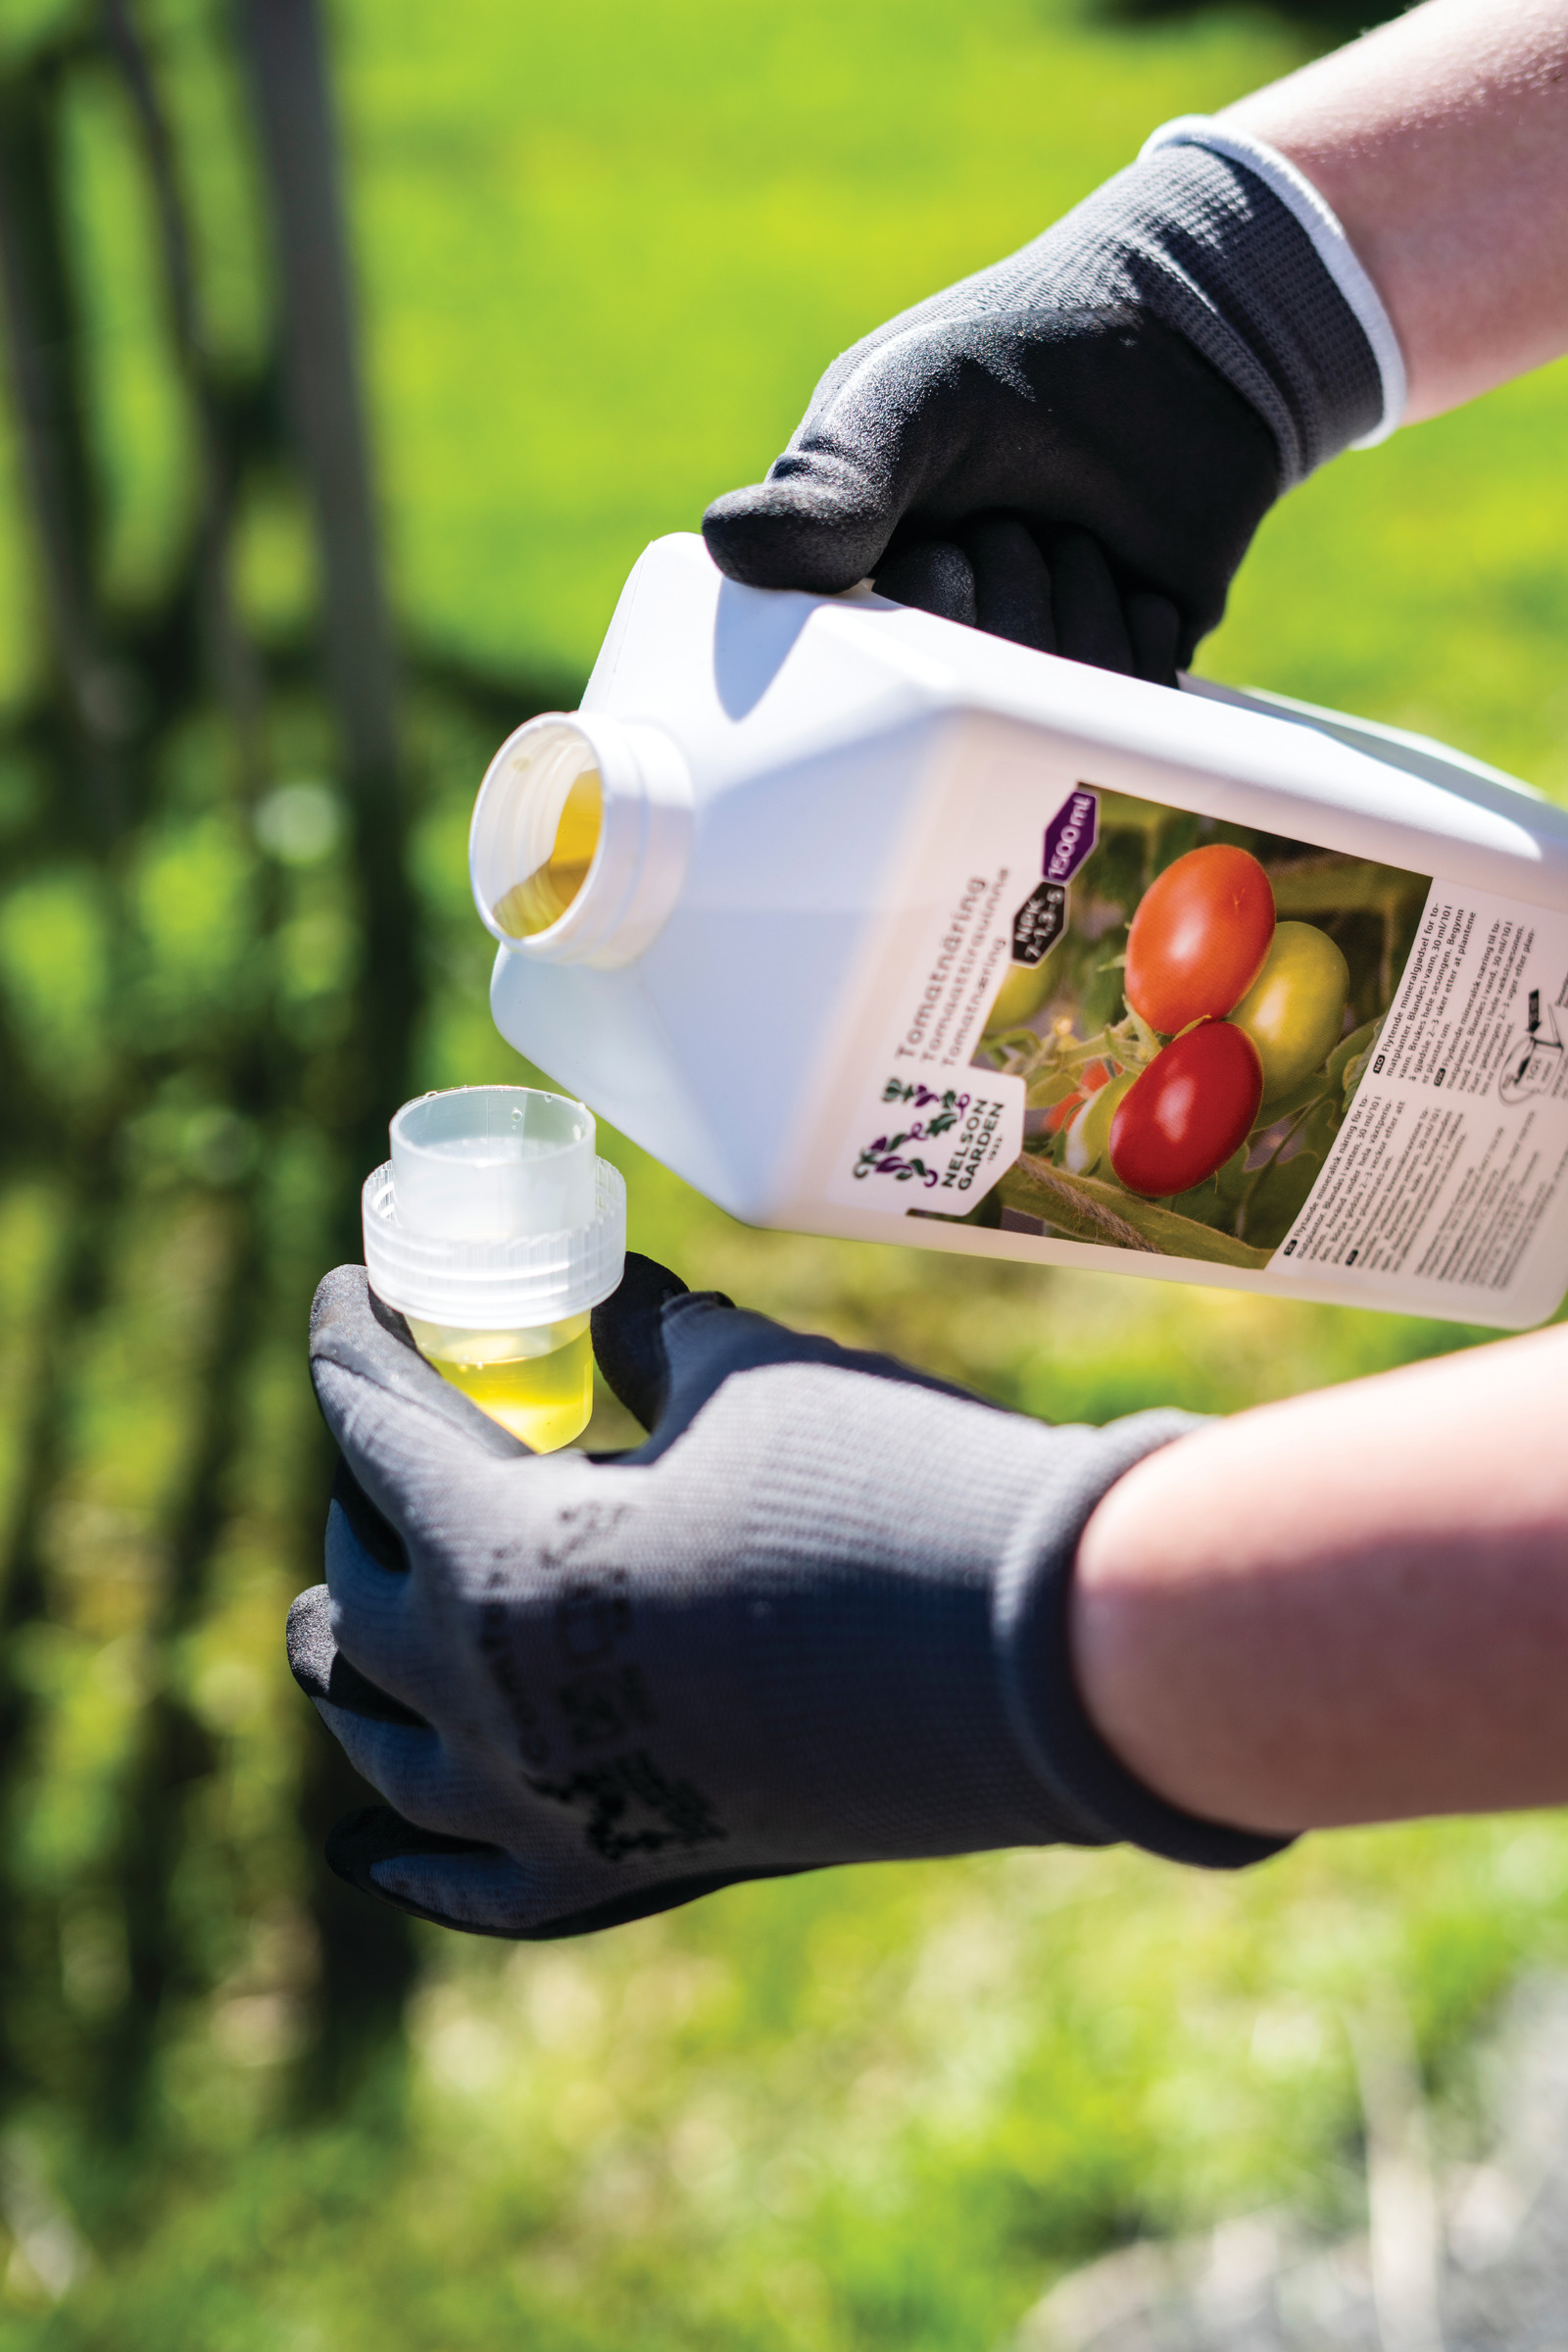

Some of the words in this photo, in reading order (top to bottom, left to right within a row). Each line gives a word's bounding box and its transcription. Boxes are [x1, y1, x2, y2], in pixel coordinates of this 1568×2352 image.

[1047, 825, 1079, 879] 1500
[1069, 794, 1091, 827] ml
[896, 878, 987, 1056] Tomatnäring
[1014, 896, 1043, 942] NPK
[1381, 1011, 1403, 1052] Flytende
[1400, 937, 1429, 1007] mineralgjødsel
[1423, 920, 1434, 934] for
[1429, 903, 1439, 916] to-
[1386, 1024, 1411, 1076] matplanter.
[1406, 985, 1426, 1020] Blandes
[1419, 954, 1437, 978] vann,
[1431, 939, 1441, 951] 30
[1397, 1054, 1412, 1078] vann.
[1407, 1020, 1426, 1051] Brukes
[1420, 998, 1434, 1017] hele
[1431, 949, 1451, 995] sesongen.
[1446, 908, 1463, 945] Begynn
[1413, 1040, 1431, 1072] gjødsle
[1436, 995, 1447, 1015] uker
[1445, 969, 1456, 993] etter
[1453, 956, 1461, 966] at
[1457, 911, 1475, 955] plantene
[1442, 1026, 1463, 1066] Flydende
[1460, 981, 1481, 1024] mineralsk
[1477, 946, 1494, 979] næring
[1487, 934, 1495, 944] til
[1491, 919, 1500, 933] to-
[1446, 1040, 1470, 1088] matplanter.
[1466, 1001, 1486, 1036] Blandes
[1484, 970, 1497, 994] vand,
[1492, 955, 1501, 966] 30
[1468, 1022, 1490, 1065] Anvendes
[1487, 996, 1499, 1016] hele
[1497, 926, 1523, 993] vækstsæsonen.
[1507, 979, 1518, 1000] uger
[1515, 955, 1526, 977] efter
[1421, 1074, 1429, 1084] er
[1426, 1040, 1444, 1073] plantet
[1440, 1021, 1450, 1038] om.
[941, 1100, 986, 1188] NELSON
[957, 1102, 1003, 1190] GARDEN
[1293, 1201, 1318, 1237] Flytande
[1316, 1156, 1341, 1200] mineralisk
[1339, 1125, 1357, 1153] näring
[1350, 1109, 1361, 1122] för
[1358, 1095, 1367, 1106] to-
[1322, 1178, 1344, 1209] Blandas
[1344, 1142, 1361, 1170] vatten,
[1356, 1128, 1367, 1139] 30
[1345, 1169, 1360, 1194] under
[1356, 1148, 1371, 1166] hela
[1384, 1116, 1397, 1138] efter
[1396, 1101, 1404, 1114] att
